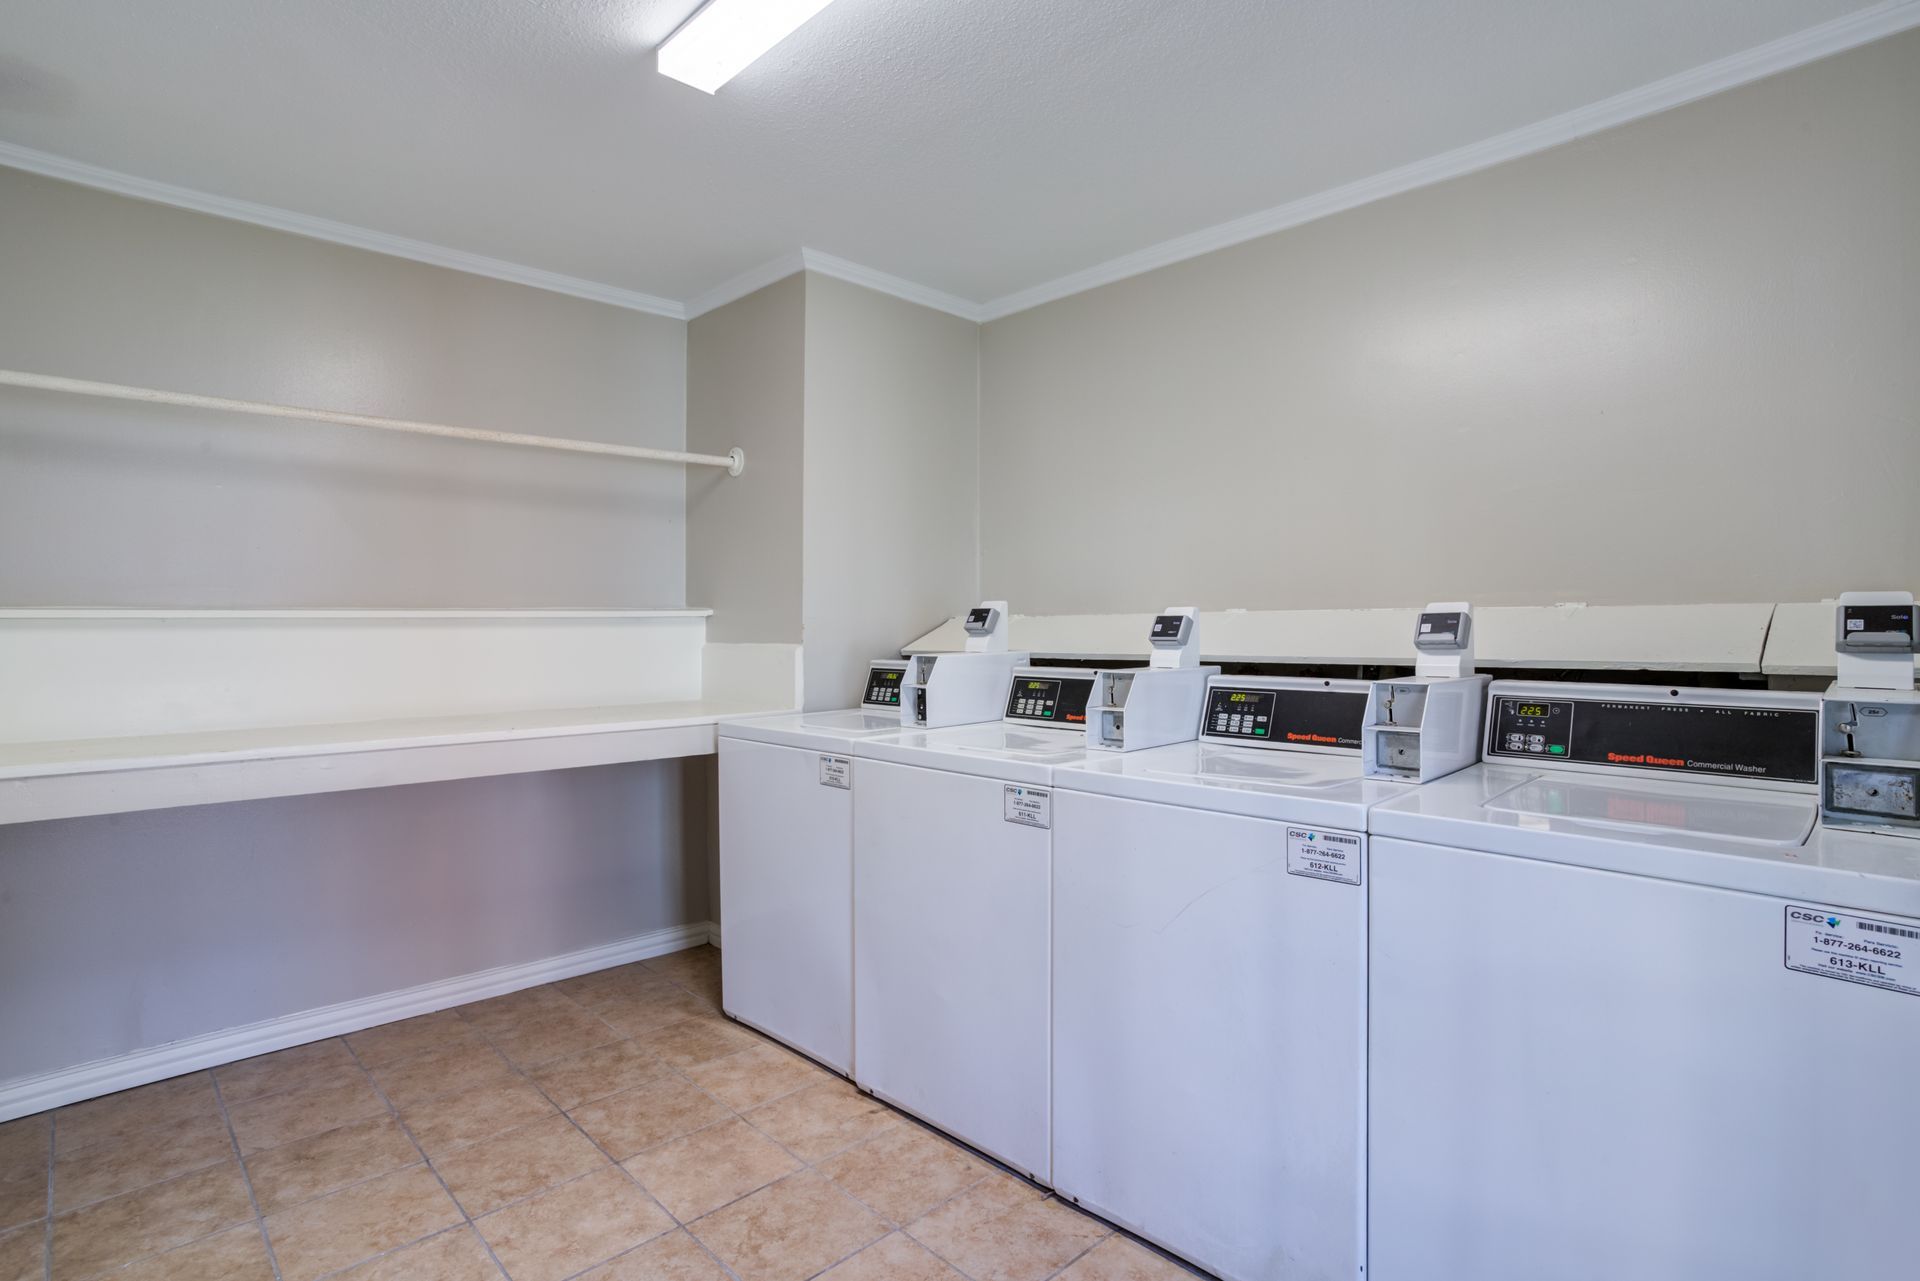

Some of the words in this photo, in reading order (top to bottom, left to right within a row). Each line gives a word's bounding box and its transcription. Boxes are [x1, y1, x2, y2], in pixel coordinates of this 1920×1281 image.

[1230, 693, 1246, 702] 225
[1520, 706, 1541, 716] 225
[1287, 732, 1311, 741] Speed
[1311, 734, 1337, 743] Queen
[1607, 752, 1644, 764] Speed
[1646, 755, 1685, 767] Queen
[1686, 759, 1734, 771] Commercial
[1735, 763, 1766, 774] Washer
[1289, 830, 1307, 838] CSC
[1790, 911, 1825, 923] CSC
[1813, 936, 1902, 959] 1-877-264-6622
[1829, 956, 1886, 976] 613-KLL
